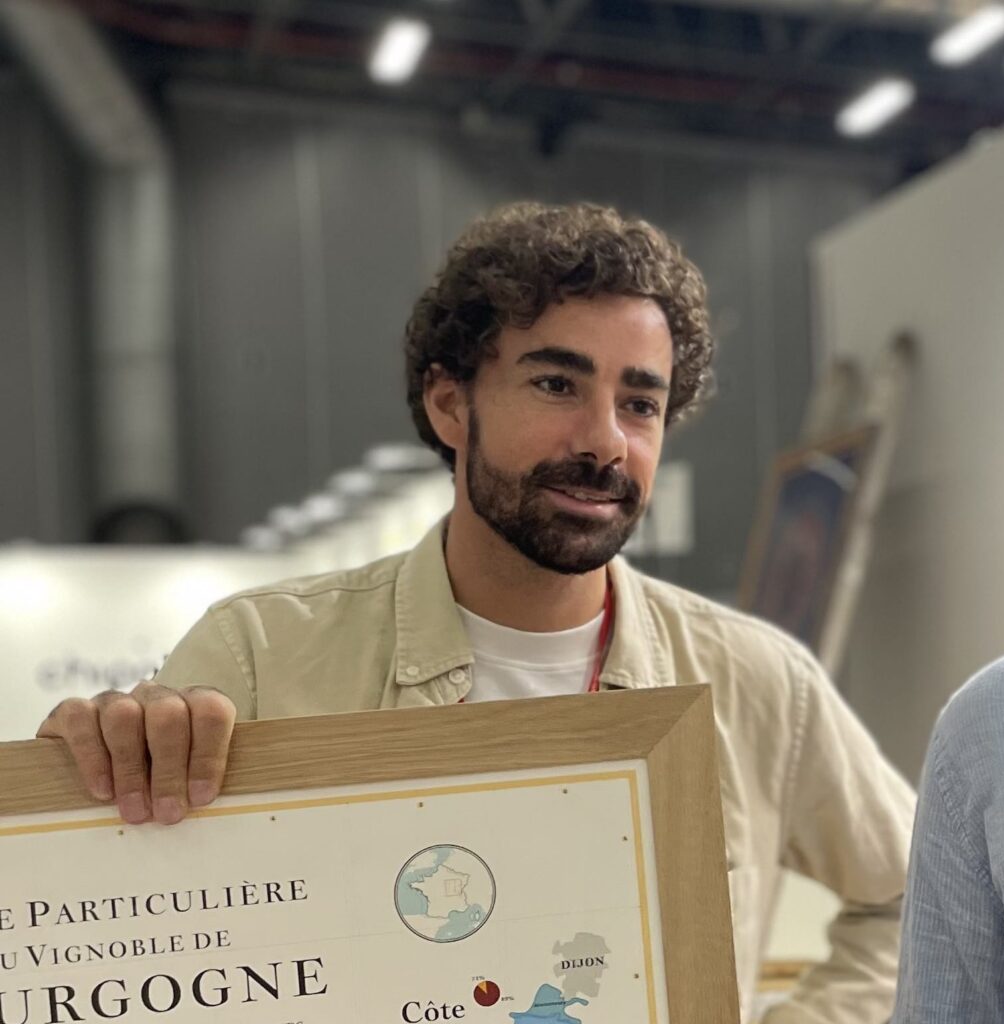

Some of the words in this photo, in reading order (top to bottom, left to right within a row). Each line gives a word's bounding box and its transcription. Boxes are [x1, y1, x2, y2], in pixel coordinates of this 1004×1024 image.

[27, 879, 309, 928] PARTICULIÈRE
[26, 940, 185, 968] VIGNOBLE
[192, 929, 232, 950] DE
[561, 955, 605, 970] DIJON
[402, 1000, 465, 1024] Côte
